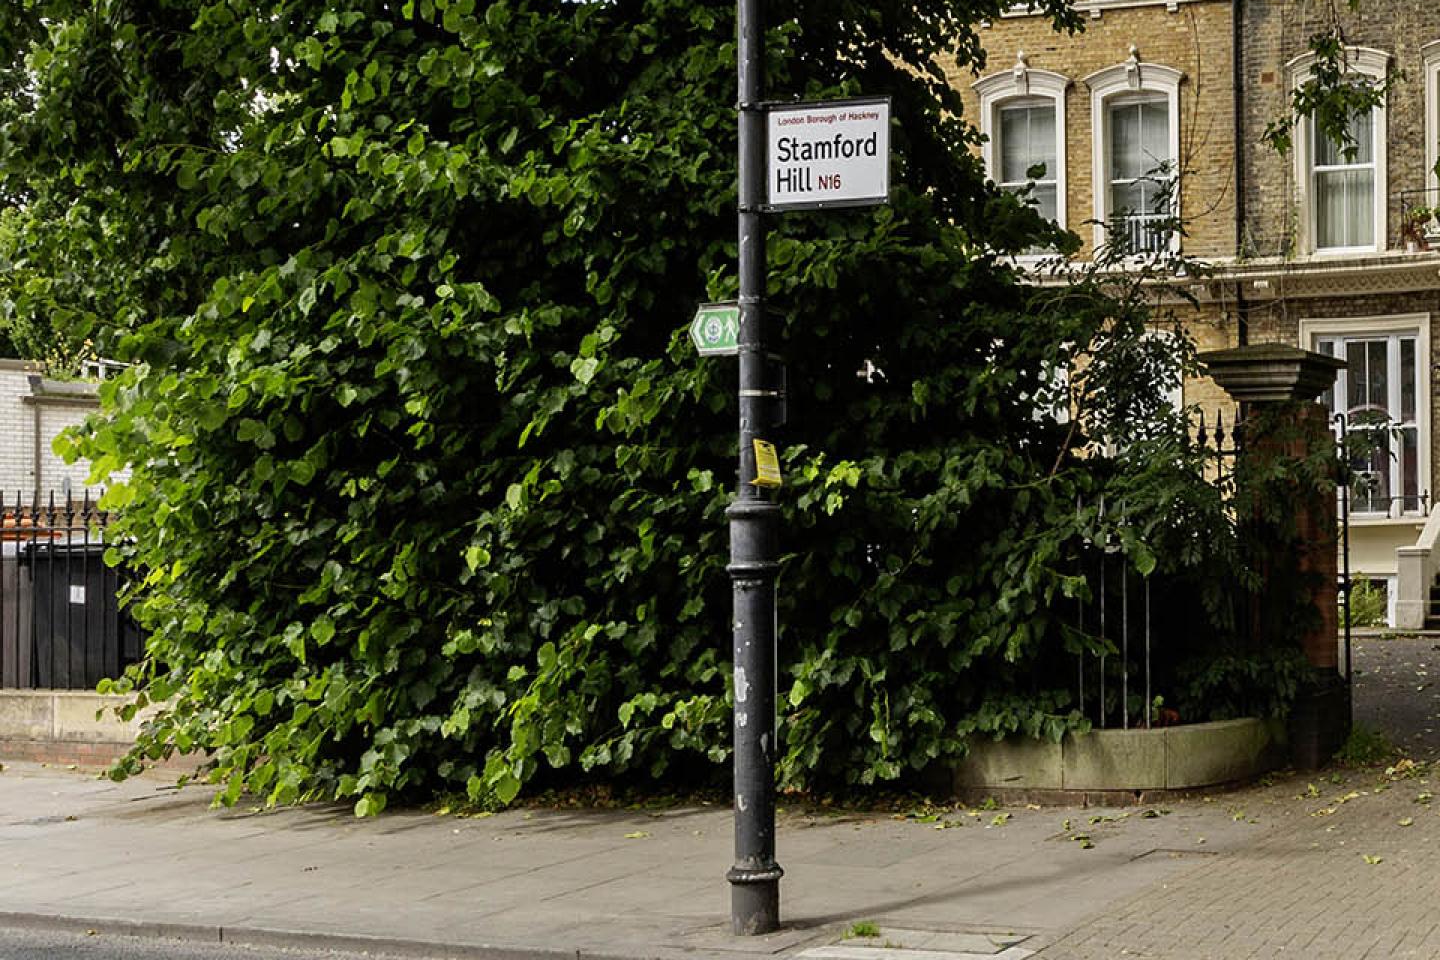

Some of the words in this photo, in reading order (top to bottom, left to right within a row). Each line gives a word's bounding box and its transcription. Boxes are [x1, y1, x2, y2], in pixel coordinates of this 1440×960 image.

[778, 117, 804, 126] London
[807, 114, 837, 124] Borough
[839, 113, 847, 121] of
[848, 111, 879, 121] Hackney
[777, 132, 877, 162] Stamford
[777, 168, 812, 192] Hill
[818, 174, 841, 190] N16
